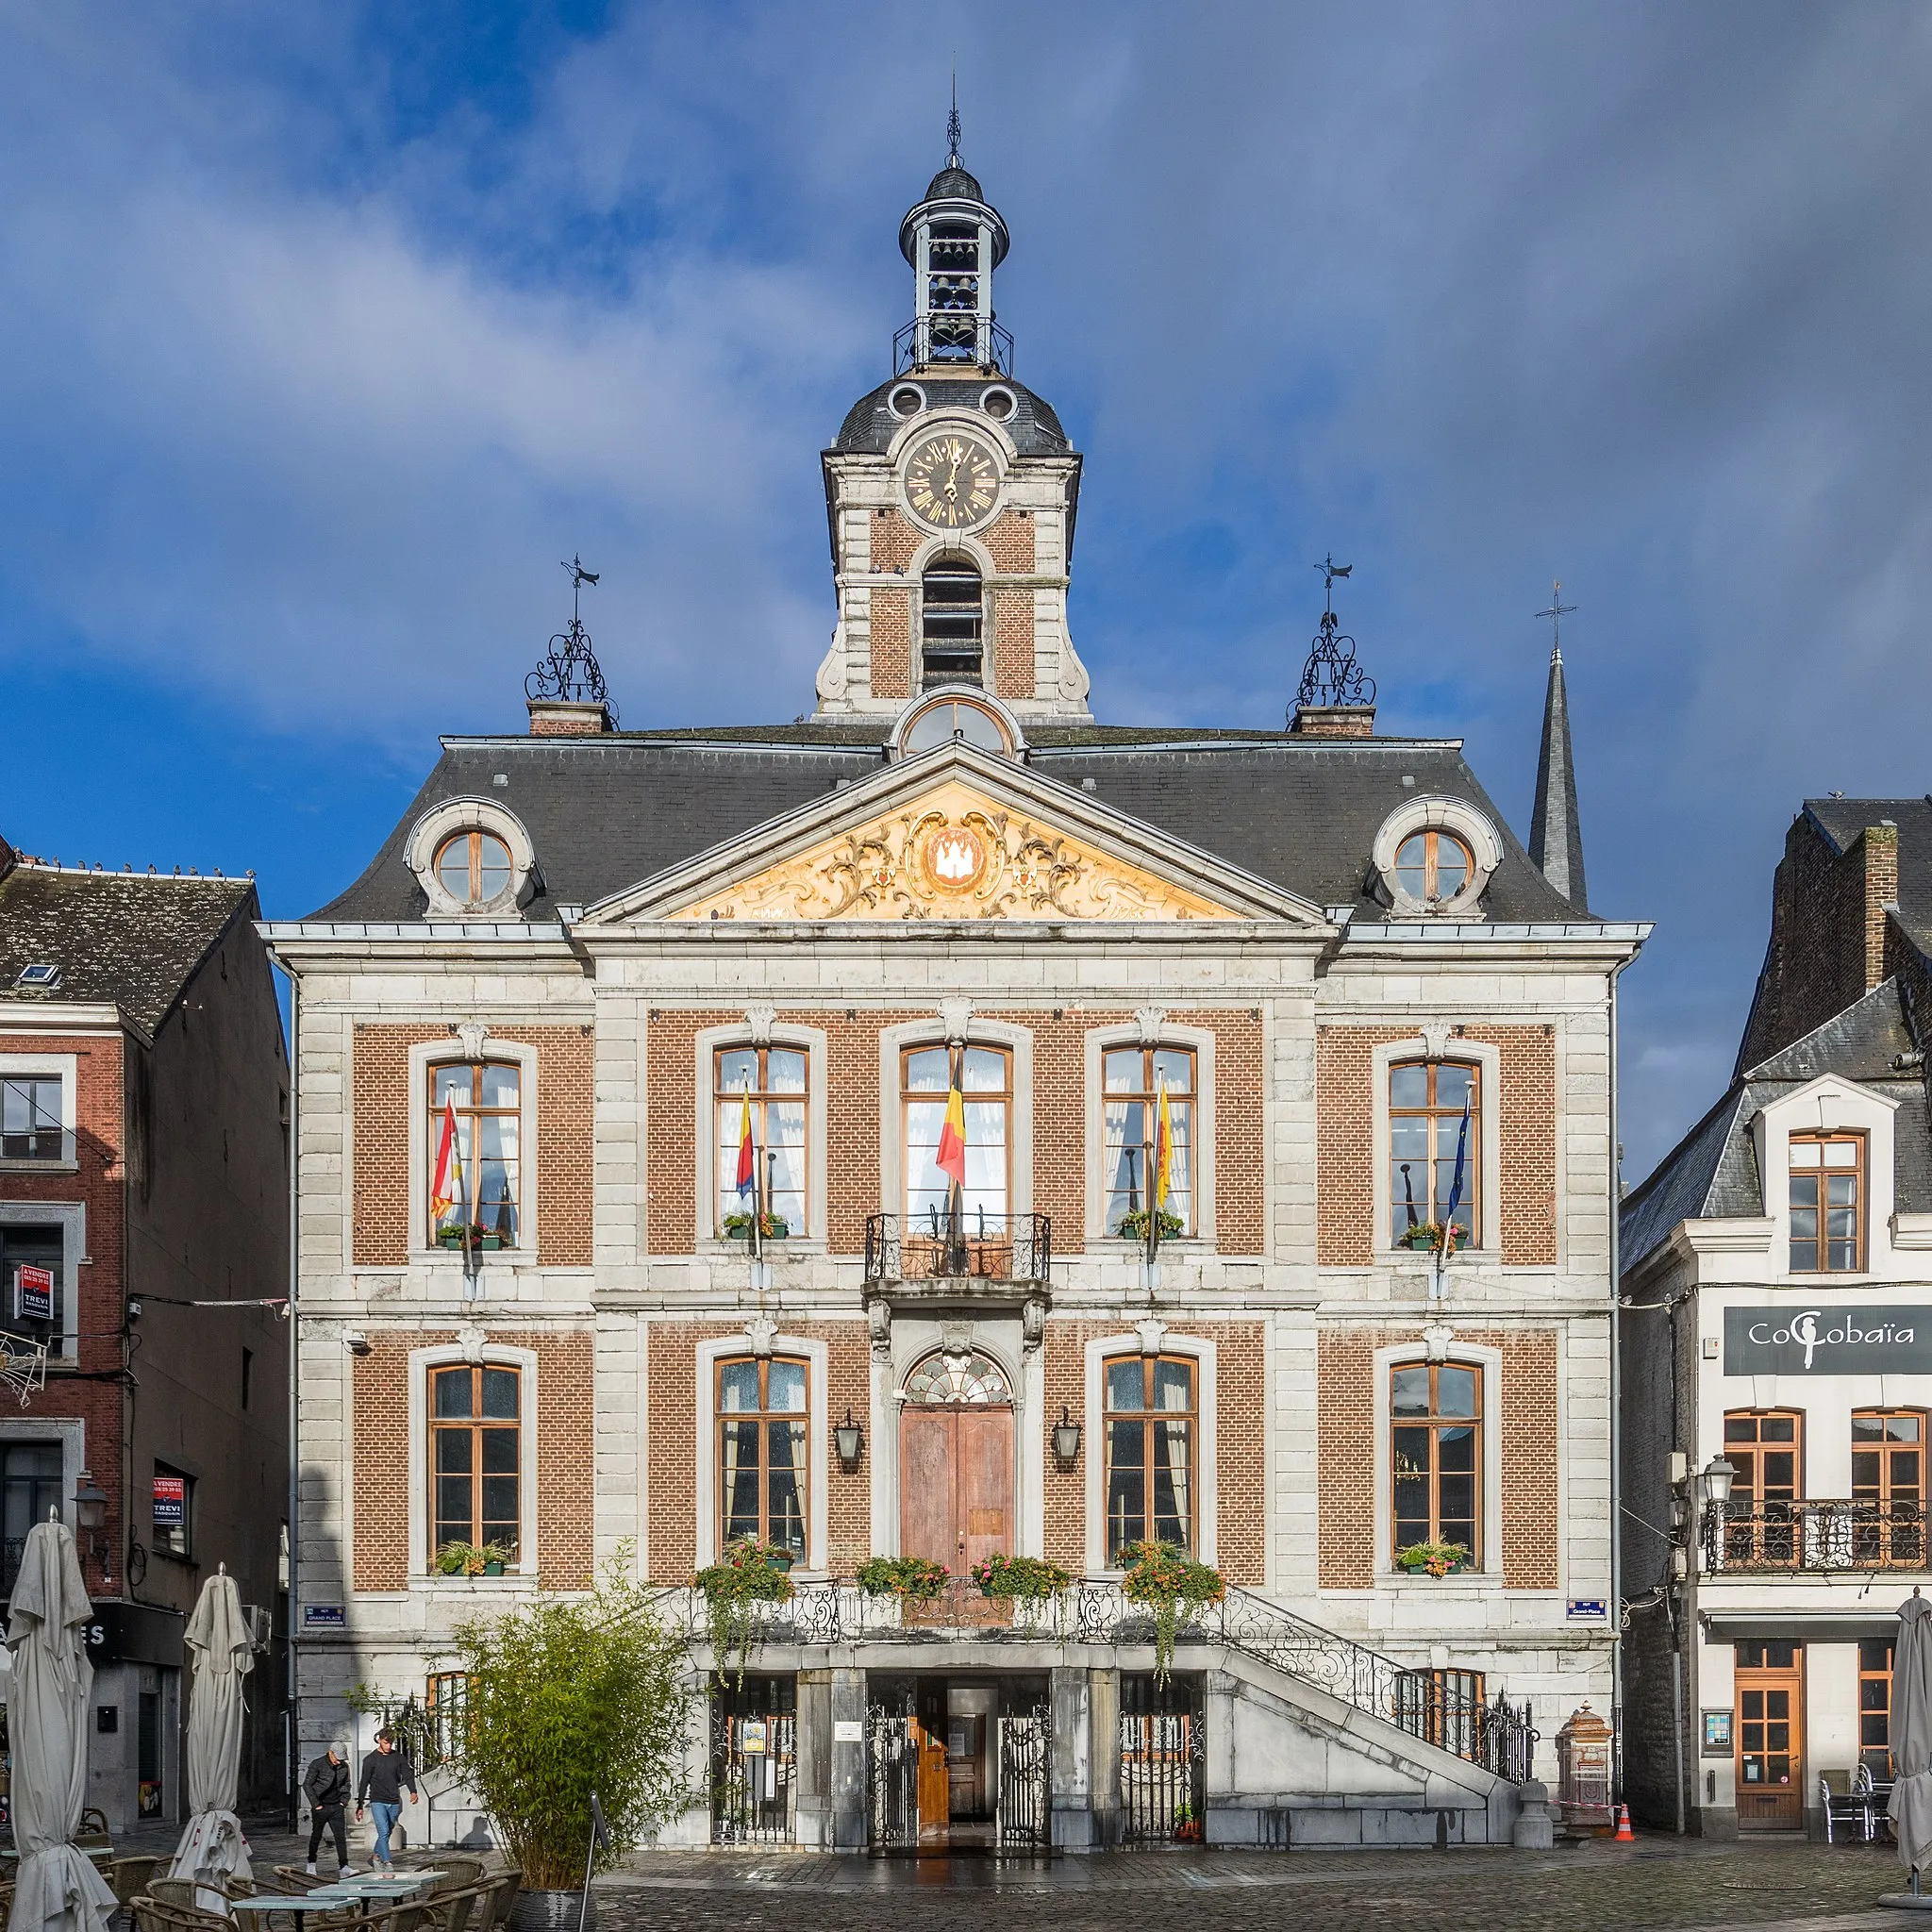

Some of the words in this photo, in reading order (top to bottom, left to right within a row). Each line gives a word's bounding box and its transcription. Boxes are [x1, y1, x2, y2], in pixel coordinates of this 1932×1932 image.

[962, 444, 975, 463] I
[912, 458, 934, 474] X
[971, 459, 991, 474] II
[974, 478, 996, 487] III
[963, 503, 975, 522] V
[28, 1270, 49, 1280] VENDRE
[25, 1294, 48, 1306] TREVI
